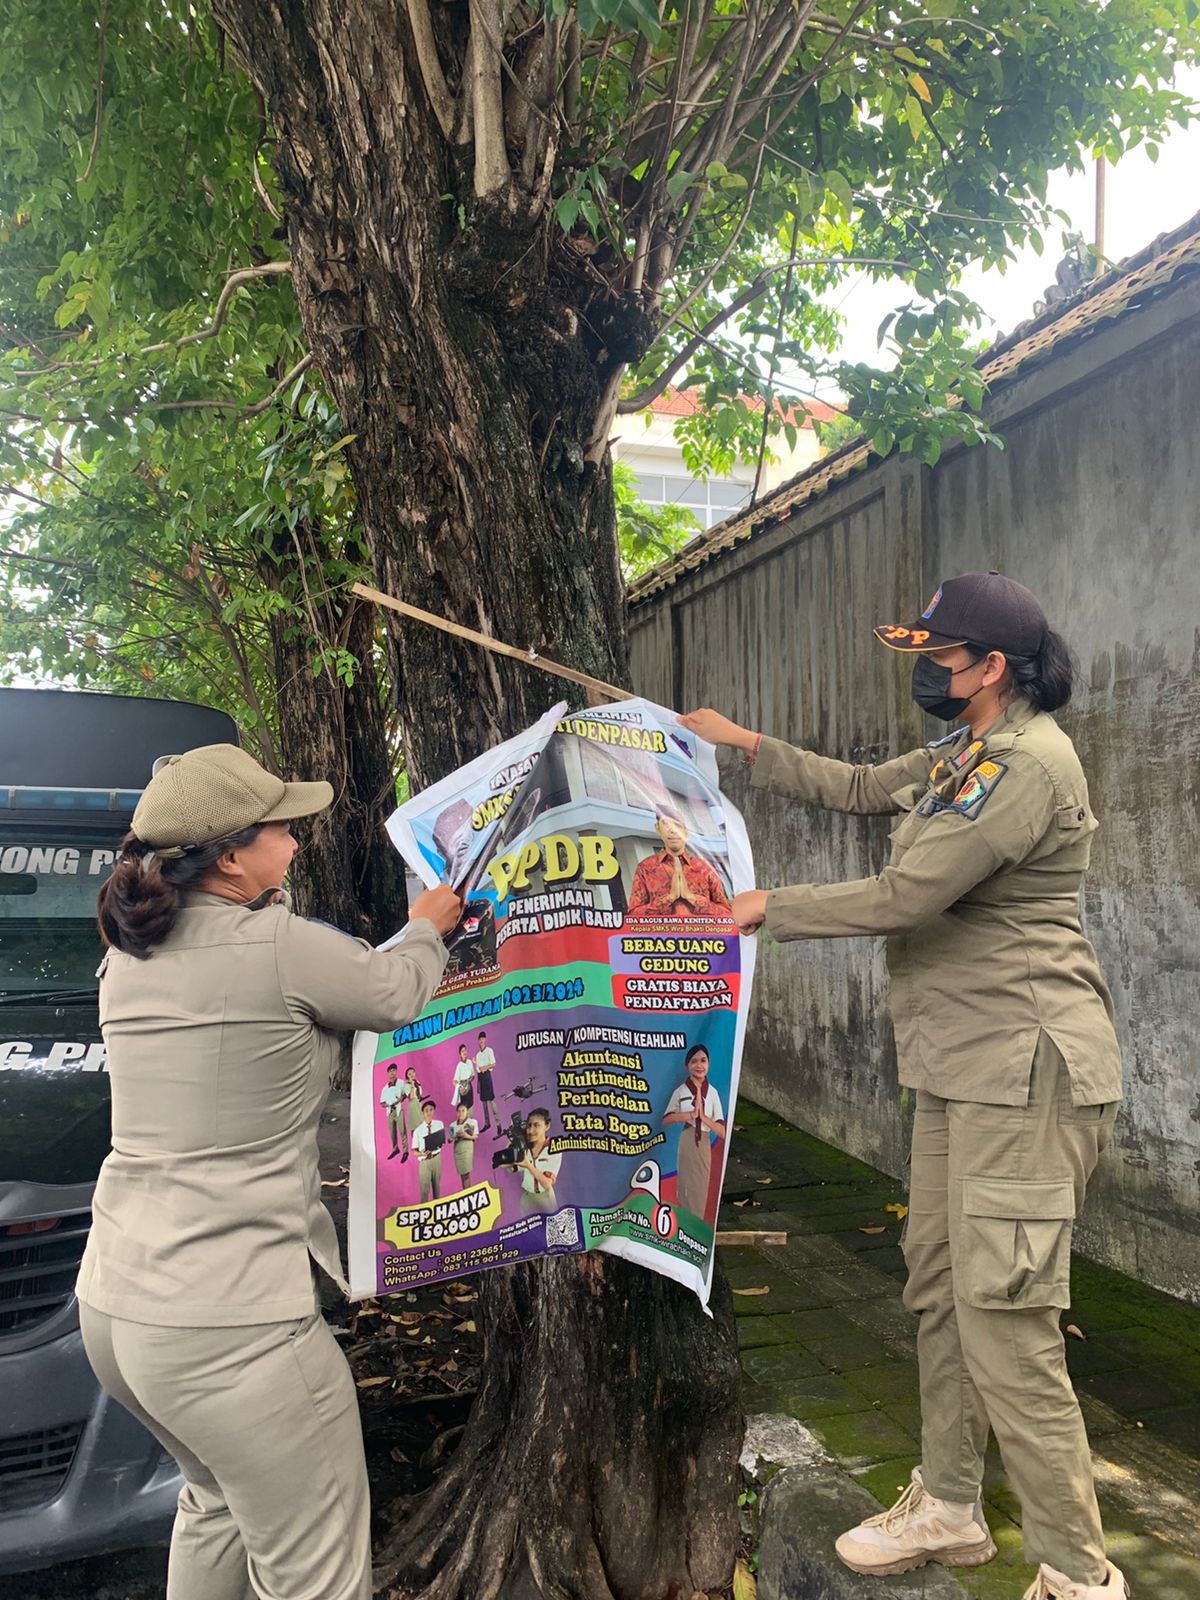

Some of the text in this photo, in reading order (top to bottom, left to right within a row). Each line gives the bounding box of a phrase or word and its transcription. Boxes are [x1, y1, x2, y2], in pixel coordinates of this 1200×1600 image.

[574, 719, 667, 753] DENPASAR
[0, 847, 80, 875] ONG
[484, 833, 622, 903] PPDB
[507, 888, 594, 919] PENERIMAAN
[495, 914, 541, 949] PESERTA
[542, 909, 582, 932] DIDIK
[584, 909, 624, 930] BARU
[625, 917, 639, 925] IDA
[640, 917, 662, 925] BAGUS
[631, 925, 651, 933] Kepala
[705, 926, 733, 934] Denpasar
[623, 938, 727, 955] BEBAS UANG
[640, 957, 711, 974] GEDUNG
[626, 978, 729, 994] GRATIS BIAYA
[392, 977, 585, 1046] TAHUN AJARAN 2023/2024
[623, 992, 734, 1010] PENDAFTARAN
[516, 1030, 565, 1050] JURUSAN
[573, 1026, 633, 1043] KOMPETENSI
[633, 1033, 686, 1048] KEAHLIAN
[561, 1050, 642, 1071] Akuntansi
[558, 1070, 649, 1092] Multimedia
[559, 1090, 651, 1113] Perhotelan
[562, 1114, 651, 1141] Tata Boga
[549, 1133, 666, 1156] Administrasi Perkantoran
[397, 1188, 490, 1227] SPP HANYA
[412, 1213, 480, 1242] 150.000
[637, 1213, 652, 1229] No.
[657, 1204, 672, 1237] 6
[678, 1229, 709, 1256] Denpasar
[384, 1248, 443, 1266] Contact Us
[384, 1263, 419, 1277] Phone
[444, 1253, 468, 1265] 0361
[469, 1243, 504, 1259] 236651
[442, 1262, 461, 1274] 083
[481, 1254, 500, 1265] 901
[501, 1248, 520, 1260] 929
